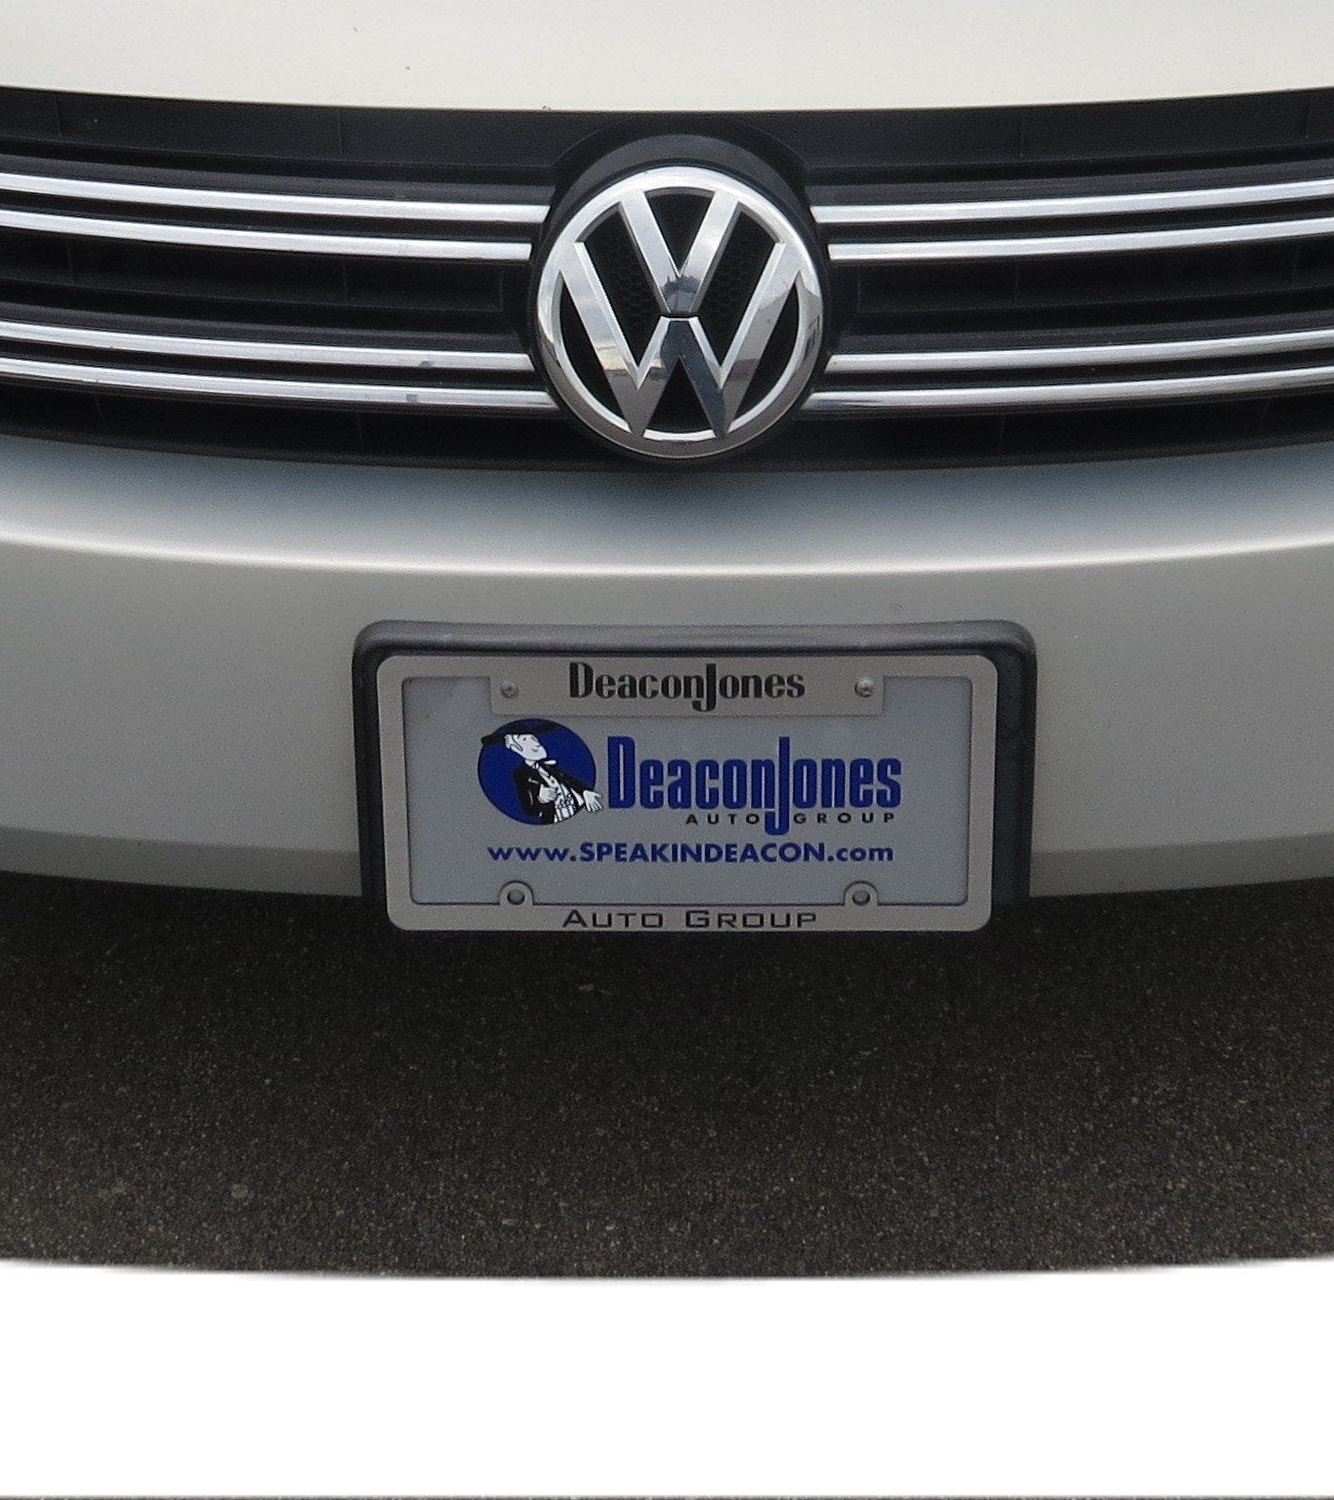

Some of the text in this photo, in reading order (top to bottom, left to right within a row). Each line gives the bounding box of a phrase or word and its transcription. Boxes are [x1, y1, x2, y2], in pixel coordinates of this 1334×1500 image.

[685, 811, 896, 826] AUTO GROUP
[487, 841, 894, 863] www.SPEAKINDEACON.com
